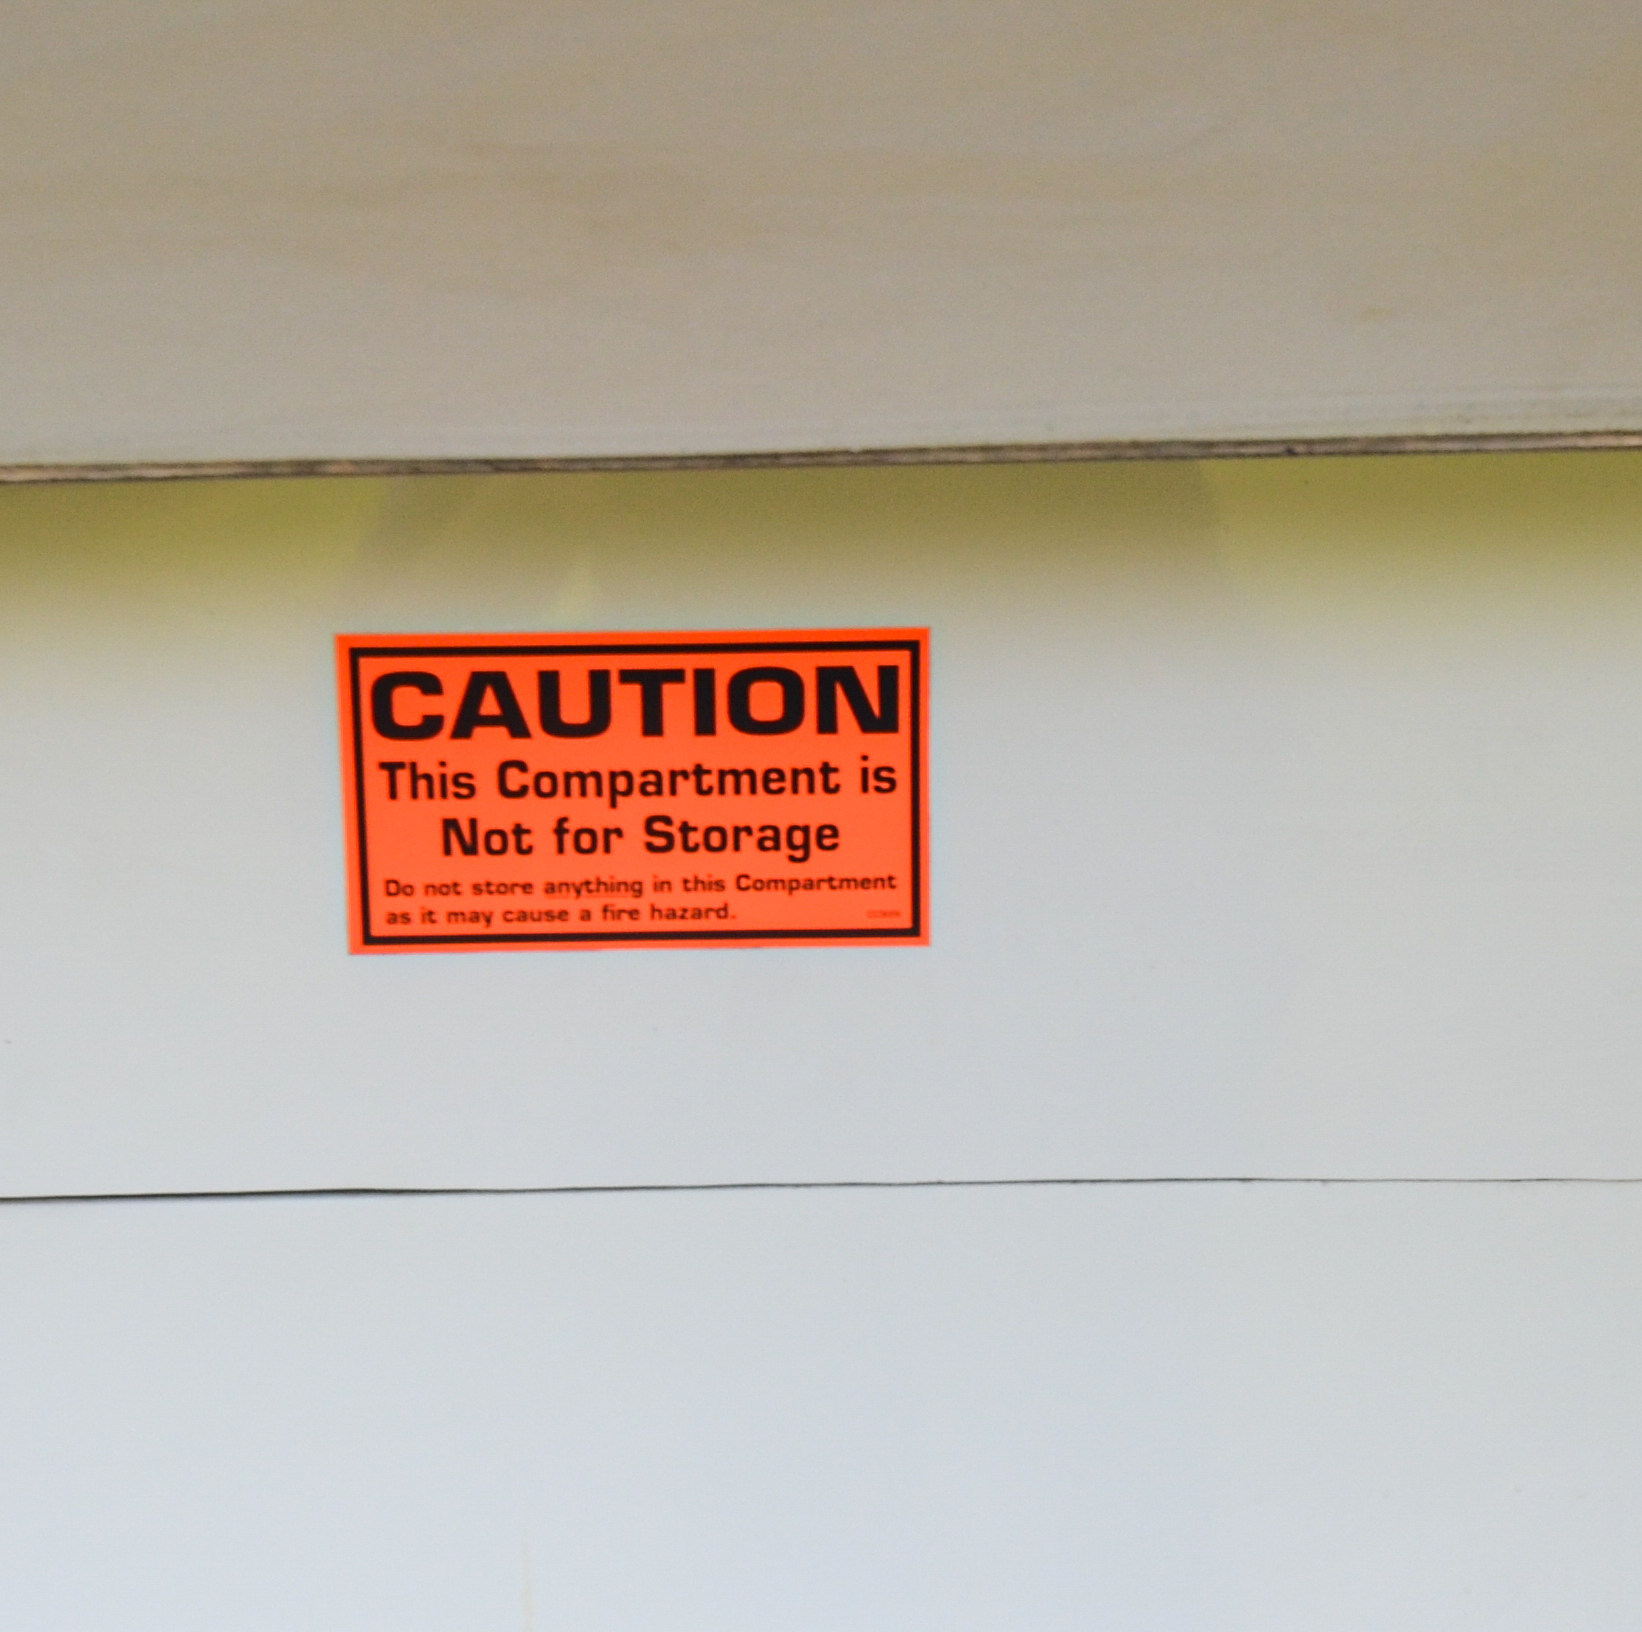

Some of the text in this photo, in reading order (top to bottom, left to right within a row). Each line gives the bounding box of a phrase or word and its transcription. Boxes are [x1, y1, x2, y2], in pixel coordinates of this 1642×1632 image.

[370, 665, 900, 740] CAUTION
[378, 755, 897, 808] This Compartment is
[442, 815, 840, 862] Not for Storage
[385, 873, 897, 899] Do not store anything in this Compartment
[387, 903, 737, 927] as it may cause a fire hazard.
